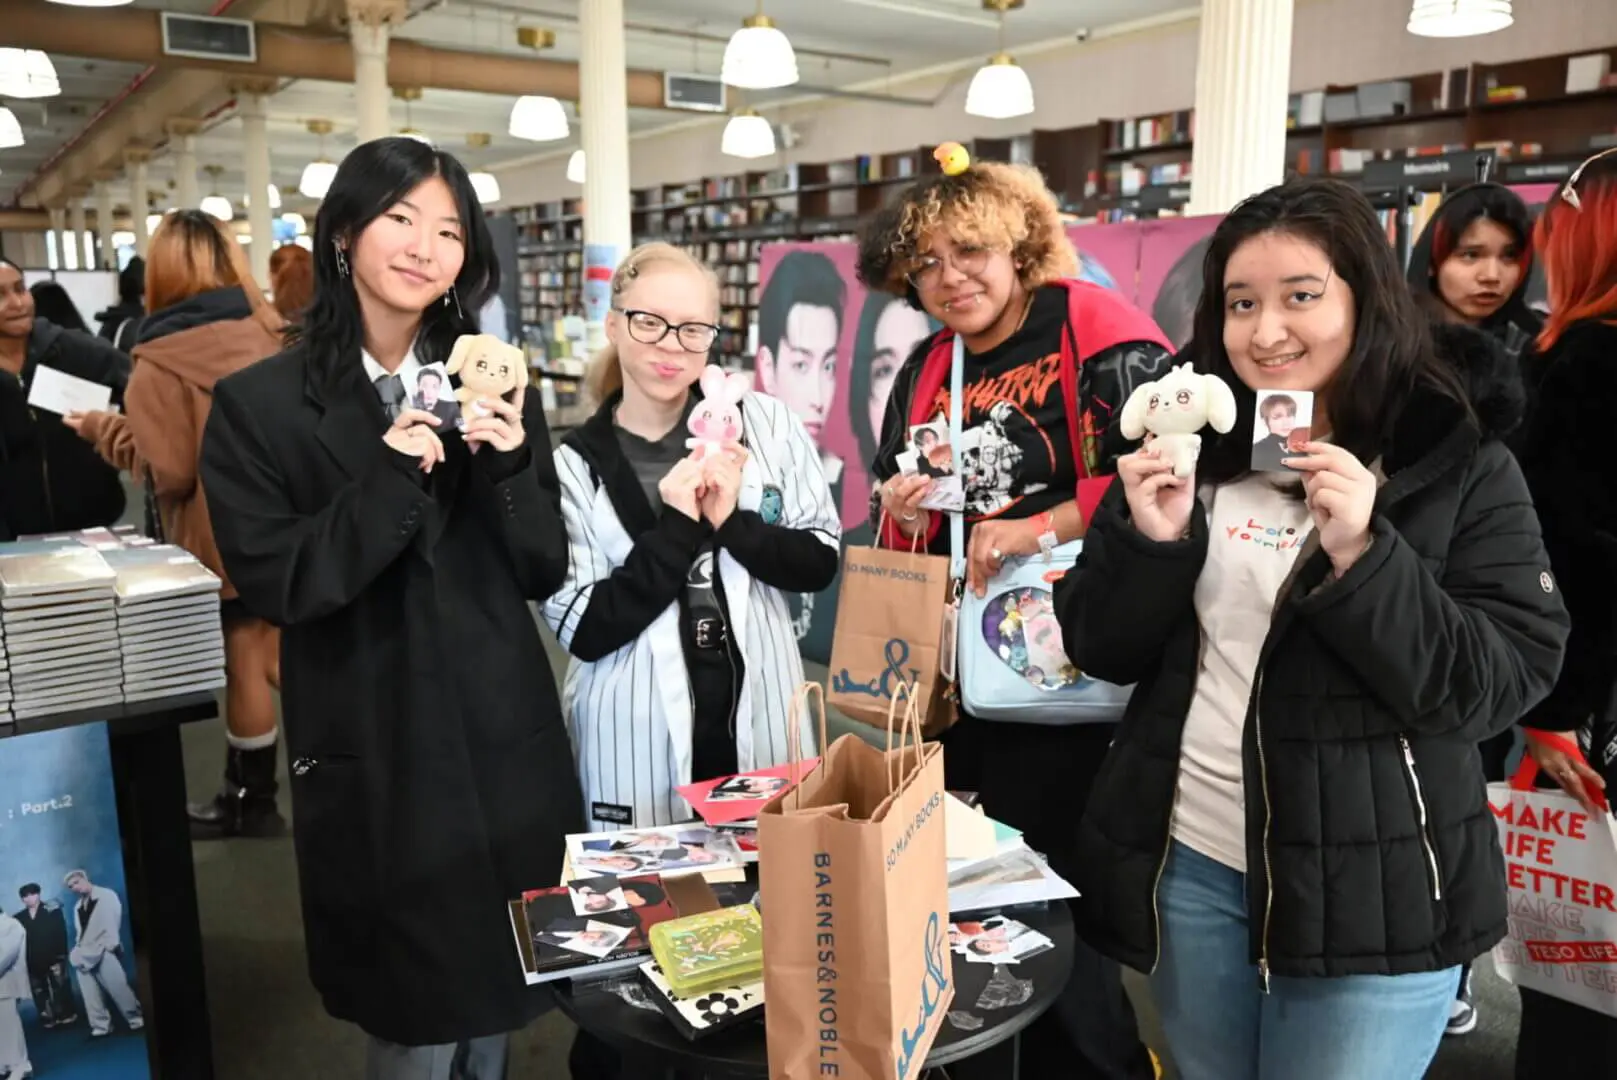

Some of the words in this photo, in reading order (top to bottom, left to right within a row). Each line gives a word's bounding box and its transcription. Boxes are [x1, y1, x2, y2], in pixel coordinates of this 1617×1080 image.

[860, 565, 888, 577] MANY
[21, 794, 73, 816] Part.2
[1488, 800, 1588, 840] MAKE
[1505, 831, 1556, 865] IFE
[1508, 861, 1617, 913] ETTER
[1508, 892, 1586, 935] AKE
[814, 852, 839, 1077] BARNES&NOBLE
[1530, 945, 1575, 960] TESO
[1580, 944, 1617, 961] LIFE
